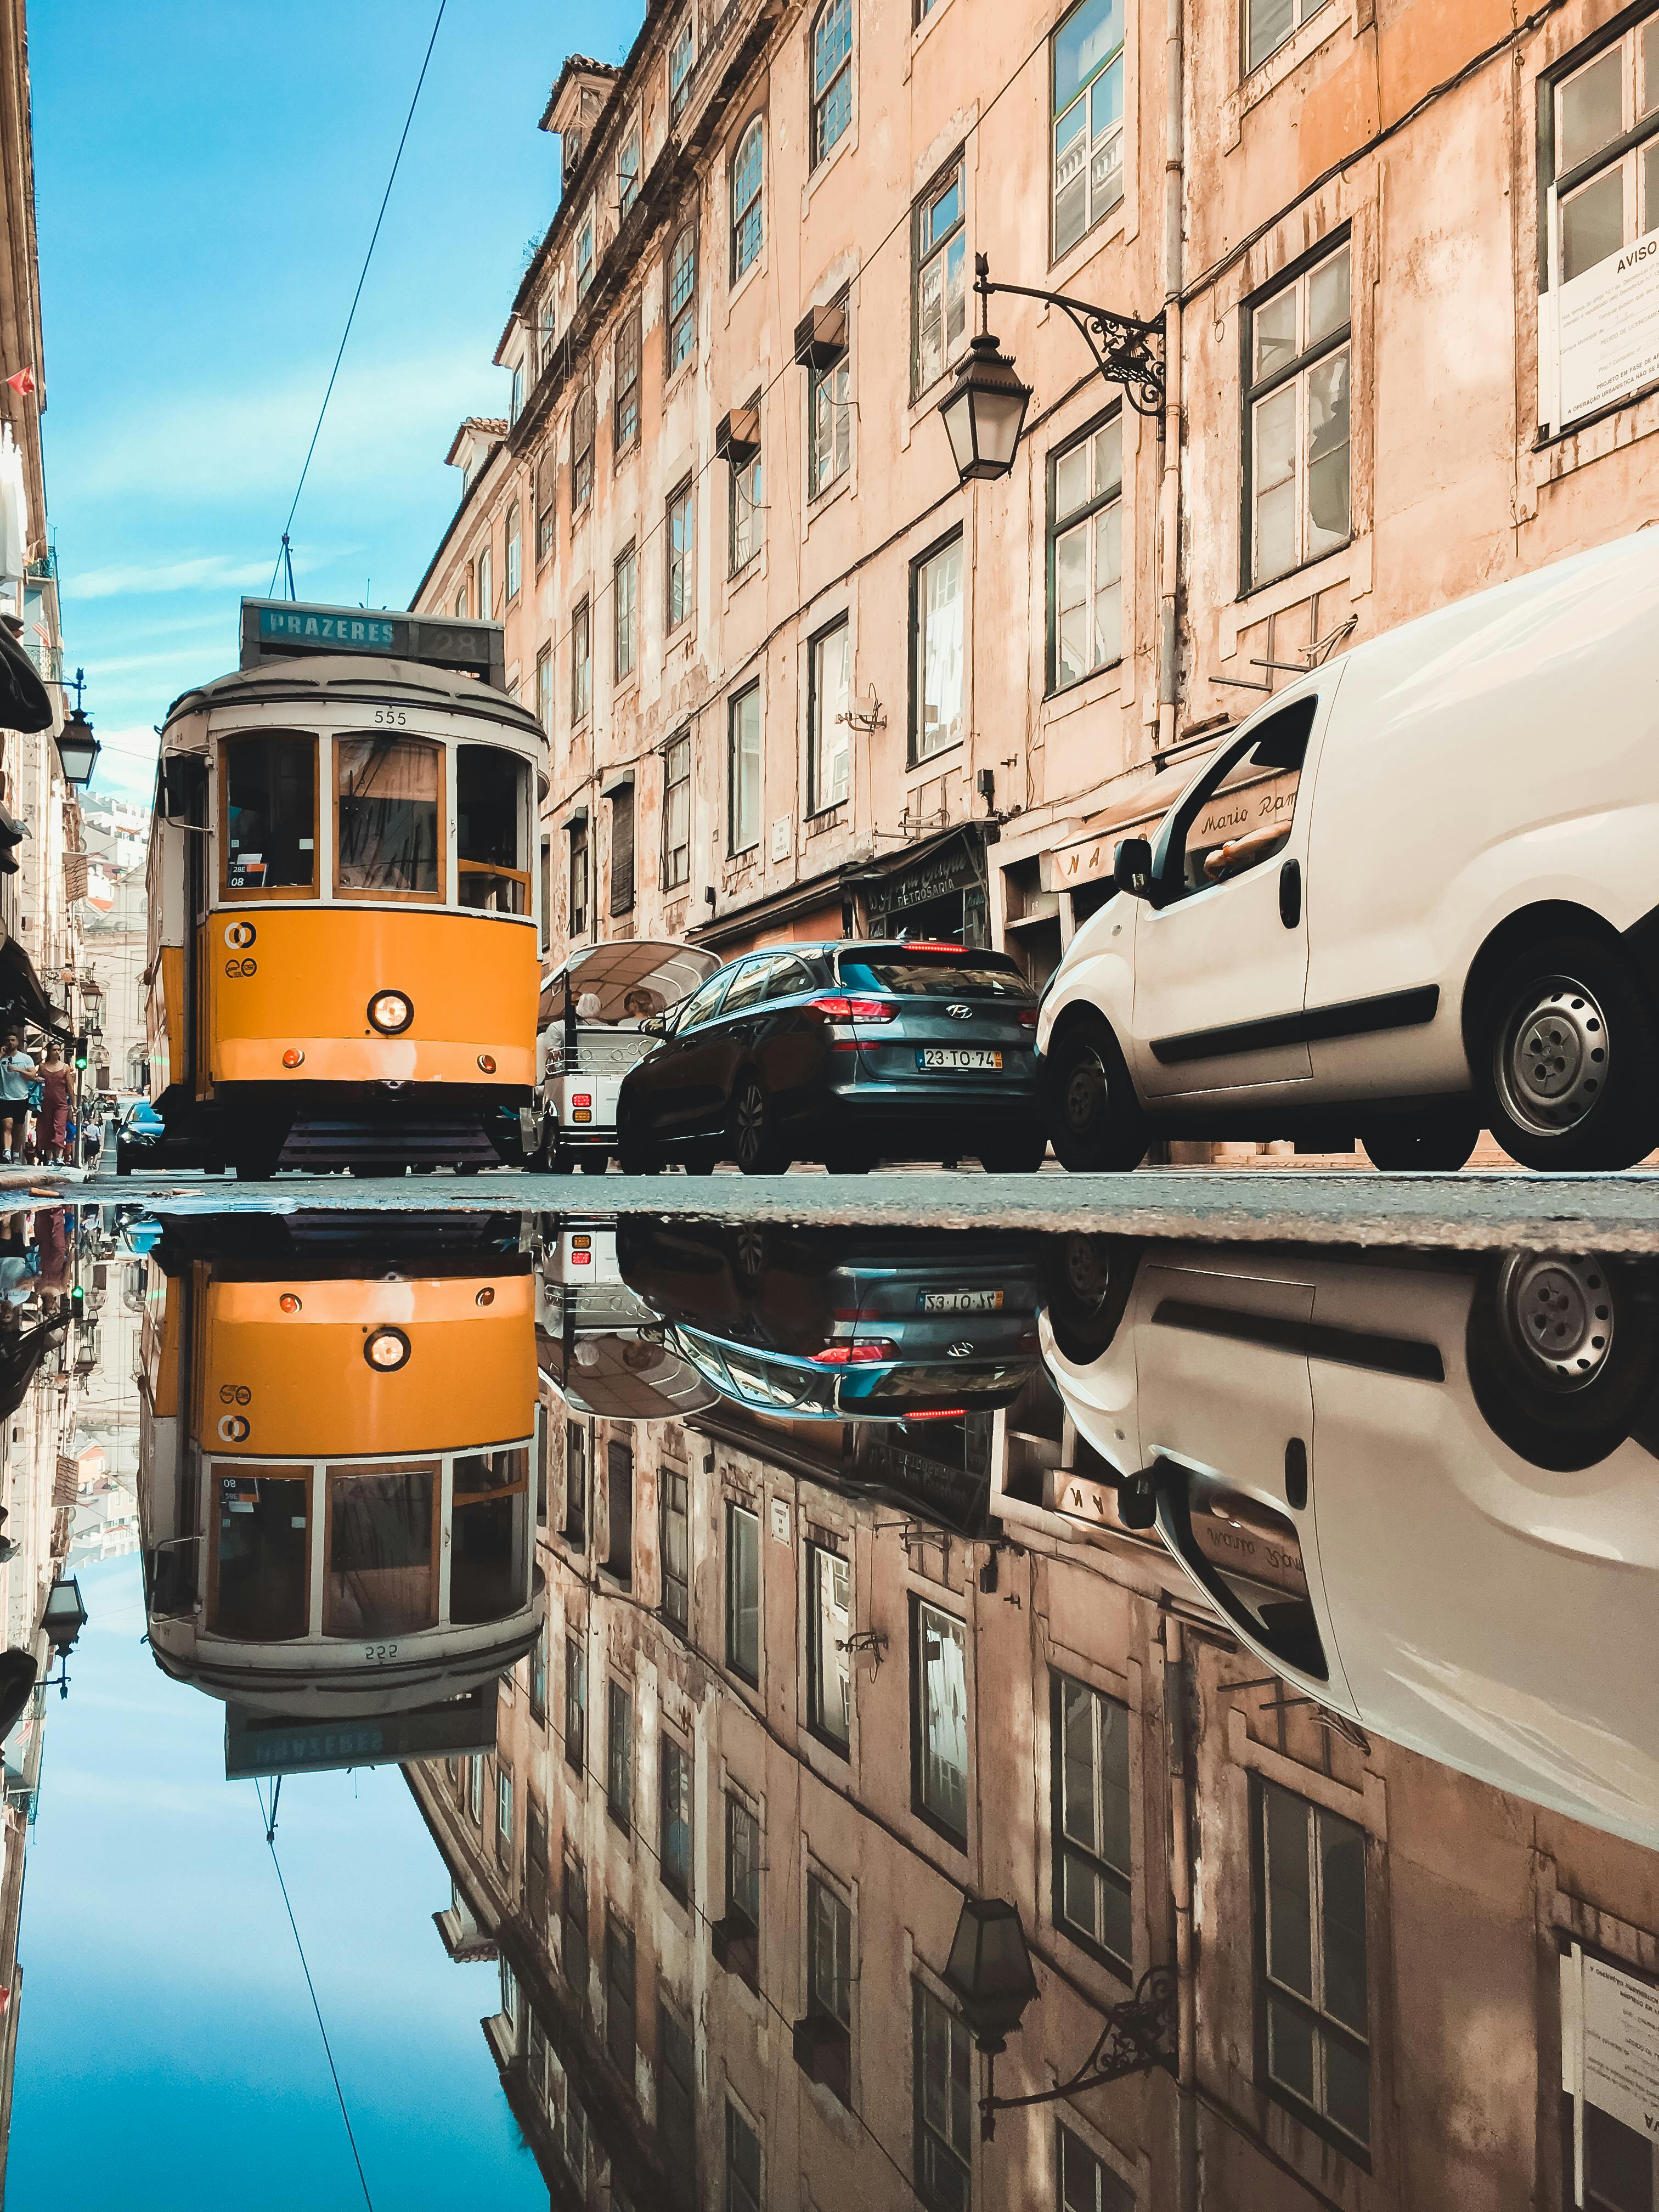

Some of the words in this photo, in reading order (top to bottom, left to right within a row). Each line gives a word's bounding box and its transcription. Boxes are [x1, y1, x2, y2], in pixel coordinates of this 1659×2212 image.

[1617, 241, 1657, 273] AVISO
[1600, 332, 1618, 346] PEDIDO
[1628, 310, 1659, 331] LICENCIAME
[1596, 375, 1619, 390] PROJETO
[1629, 362, 1643, 373] FASE
[269, 612, 396, 642] PRAZERES
[374, 710, 407, 725] 555
[1201, 807, 1248, 834] Mario
[231, 878, 244, 887] 08
[898, 878, 955, 907] RETROSARIA
